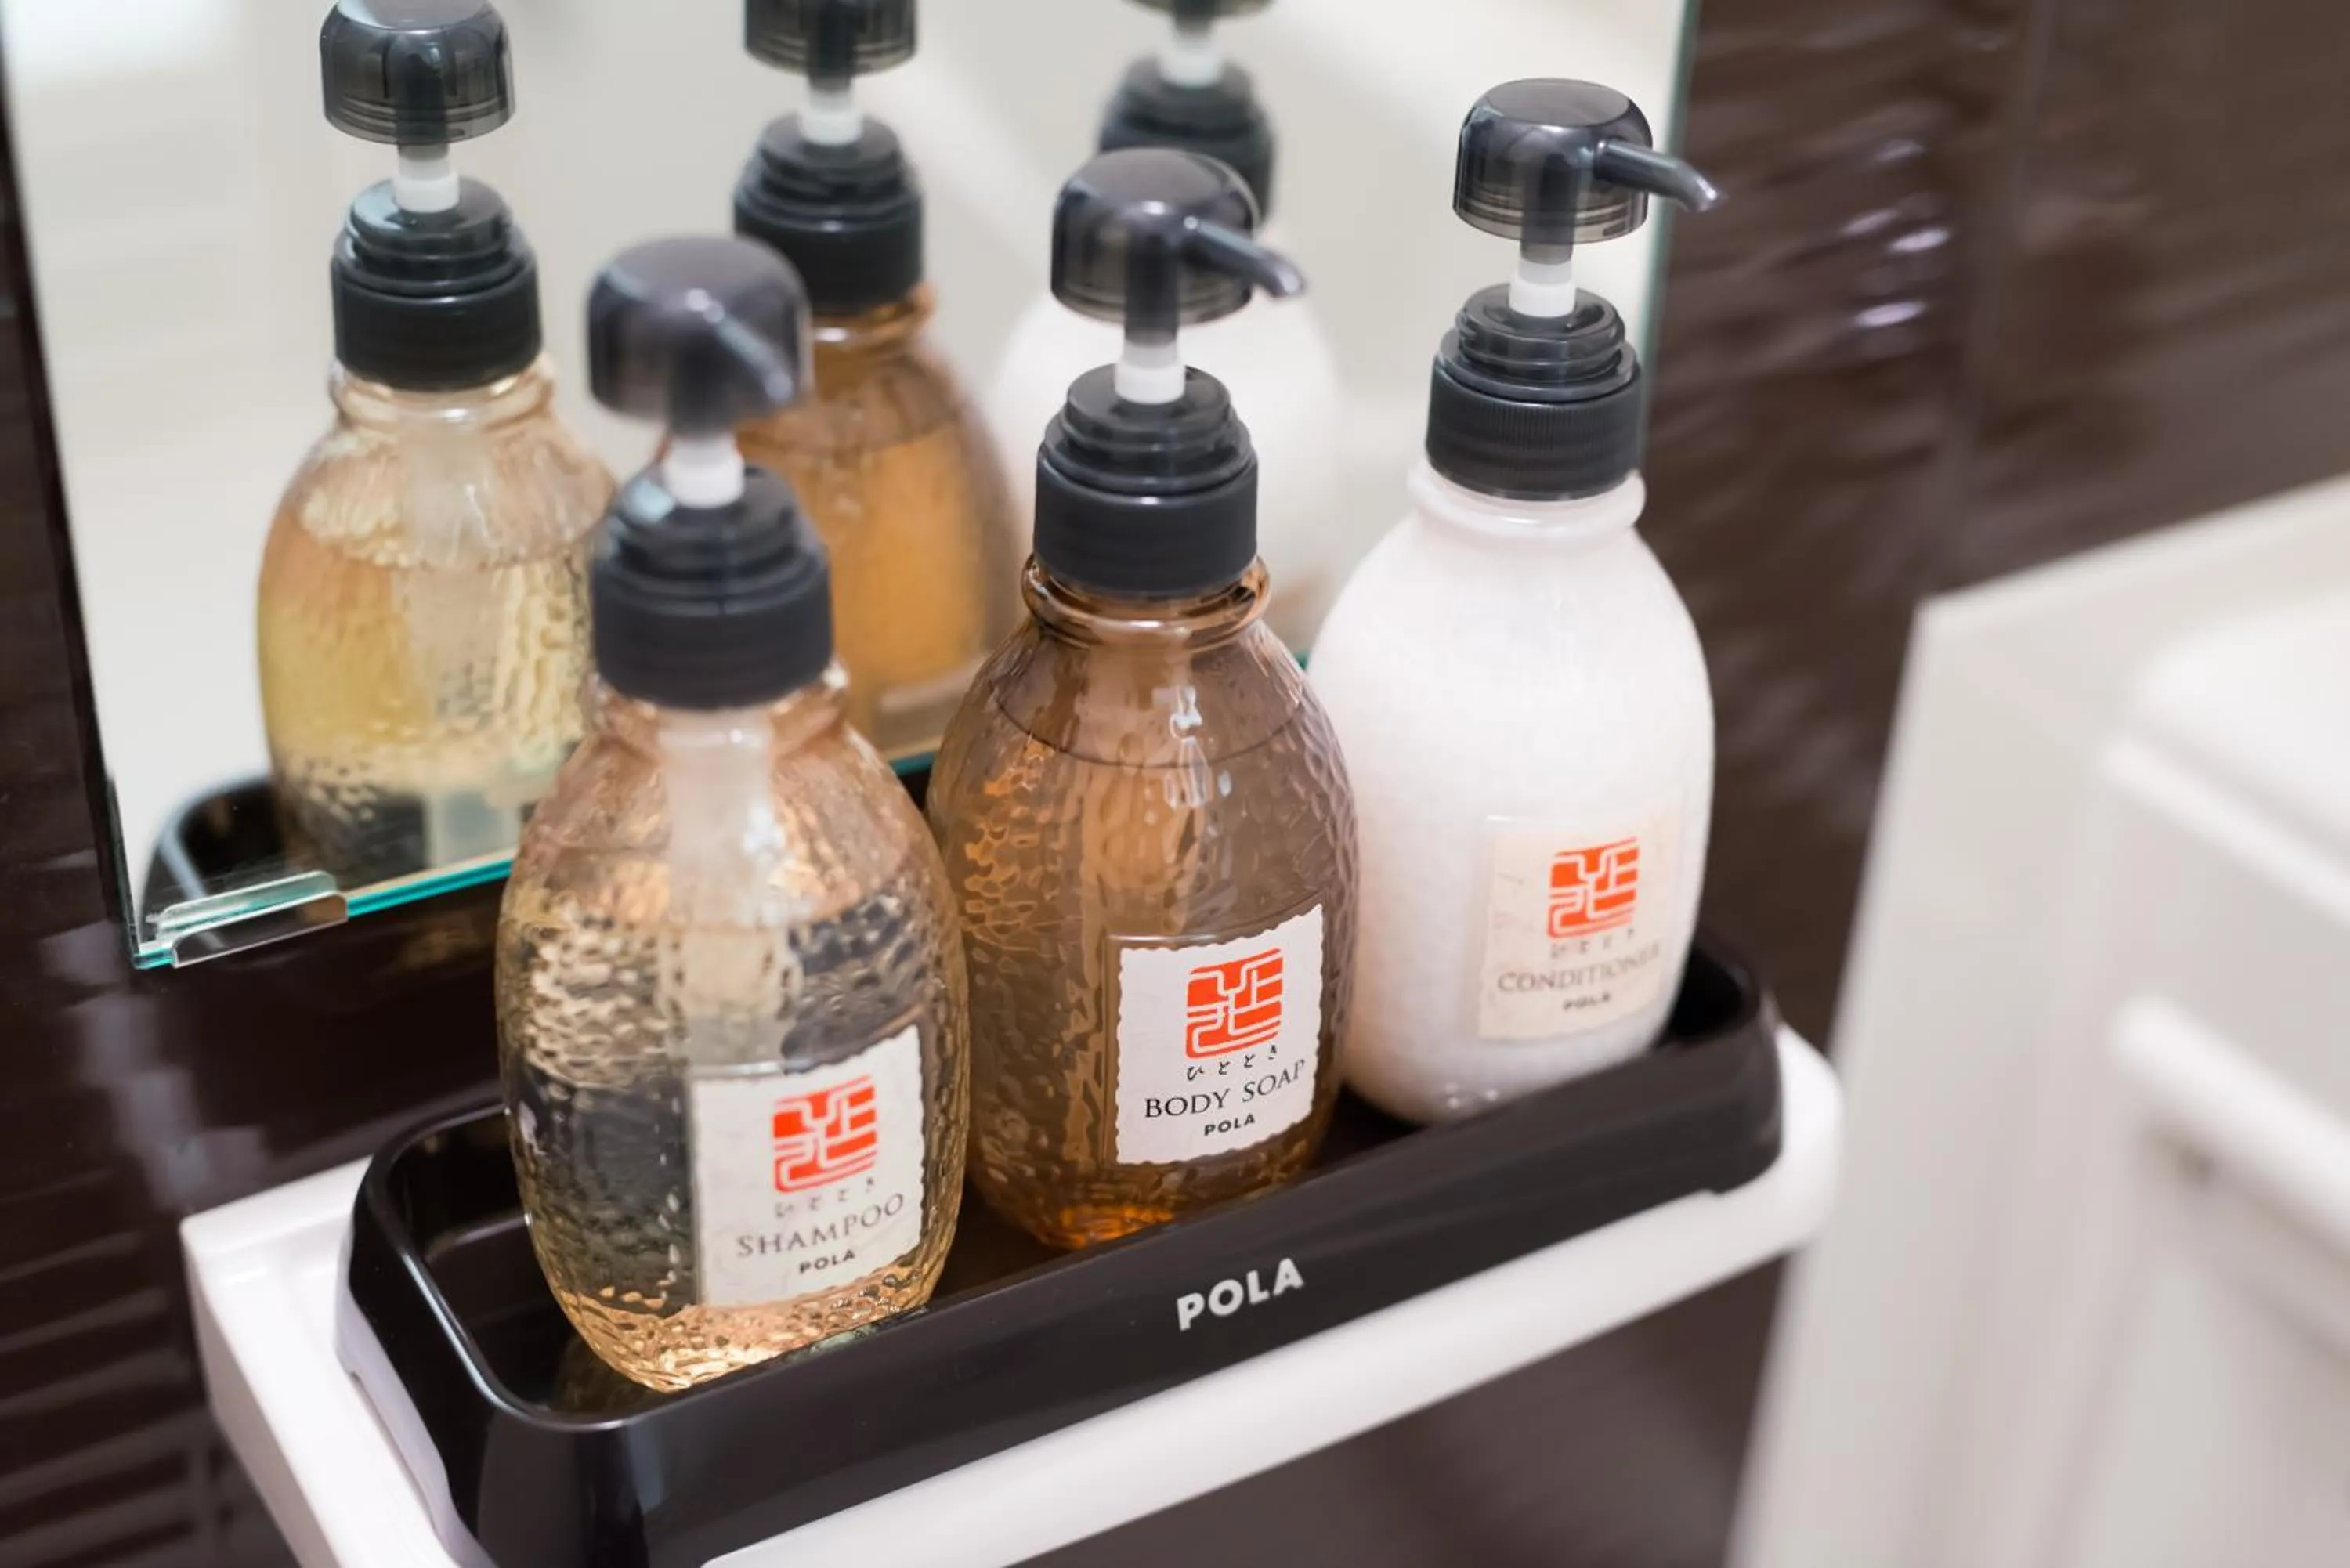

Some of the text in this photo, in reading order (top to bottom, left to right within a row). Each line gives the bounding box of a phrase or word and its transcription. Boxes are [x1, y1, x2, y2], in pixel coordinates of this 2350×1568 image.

[1562, 992, 1612, 1011] POLA
[1144, 1060, 1305, 1118] BODY SOAP
[1203, 1114, 1256, 1136] POLA
[736, 1193, 905, 1259] SHAMPOO
[799, 1248, 856, 1274] POLA
[1177, 1257, 1304, 1331] POLA
